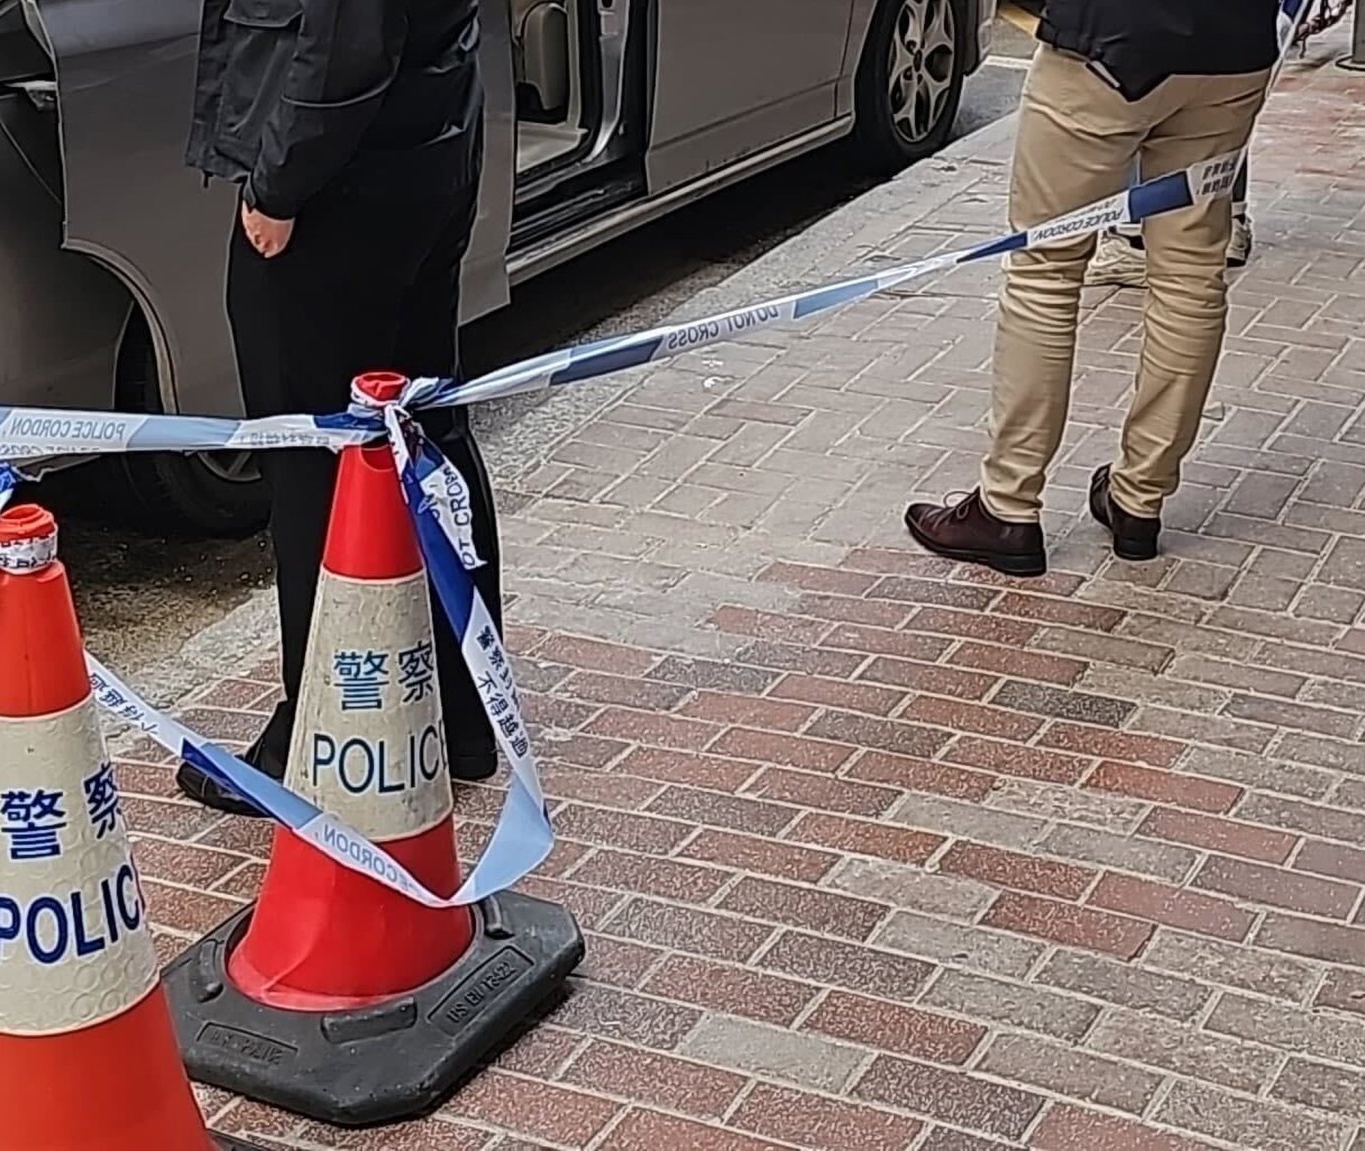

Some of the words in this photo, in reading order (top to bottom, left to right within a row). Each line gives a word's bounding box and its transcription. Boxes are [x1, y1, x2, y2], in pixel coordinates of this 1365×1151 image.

[456, 539, 477, 569] OT
[333, 640, 434, 711] 警察
[477, 671, 531, 759] 不得越過
[312, 720, 450, 795] POLIC
[0, 760, 122, 860] 警察
